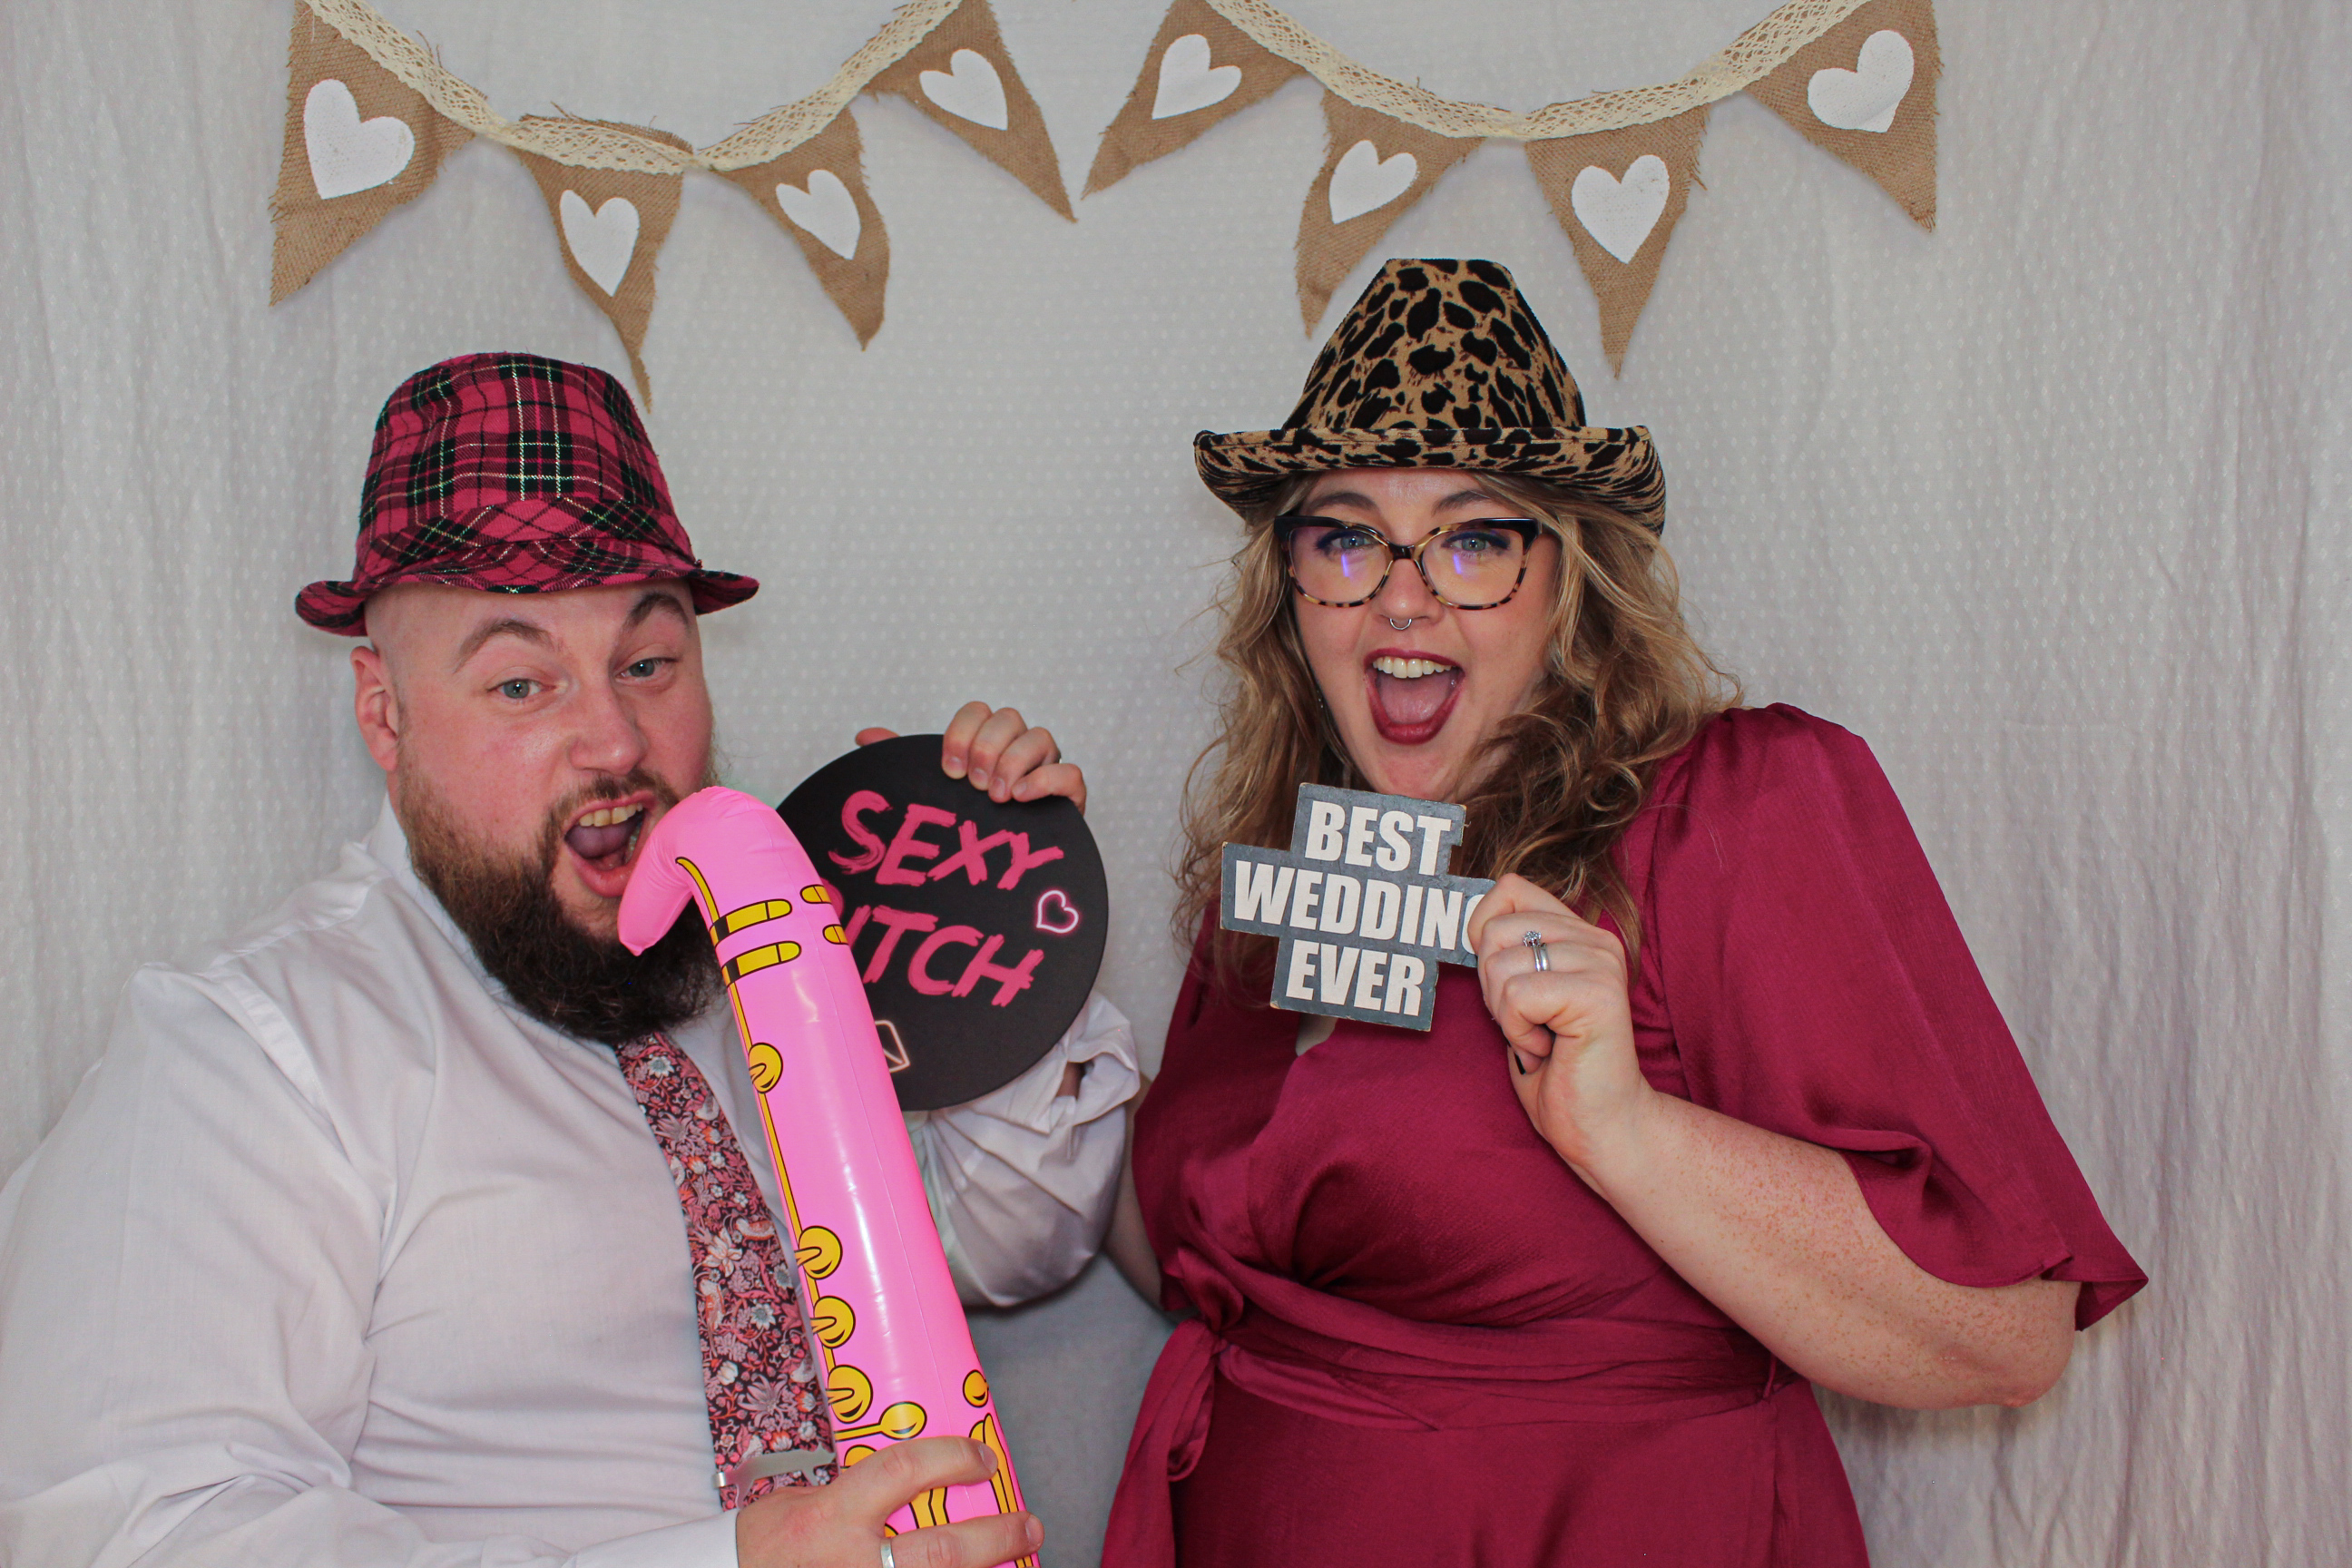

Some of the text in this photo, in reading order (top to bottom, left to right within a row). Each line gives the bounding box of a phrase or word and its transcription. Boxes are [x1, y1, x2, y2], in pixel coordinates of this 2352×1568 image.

[827, 789, 1064, 890] SEXY
[1304, 799, 1452, 877] BEST
[820, 877, 1044, 1007] ITCH
[1285, 938, 1426, 1017] EVER
